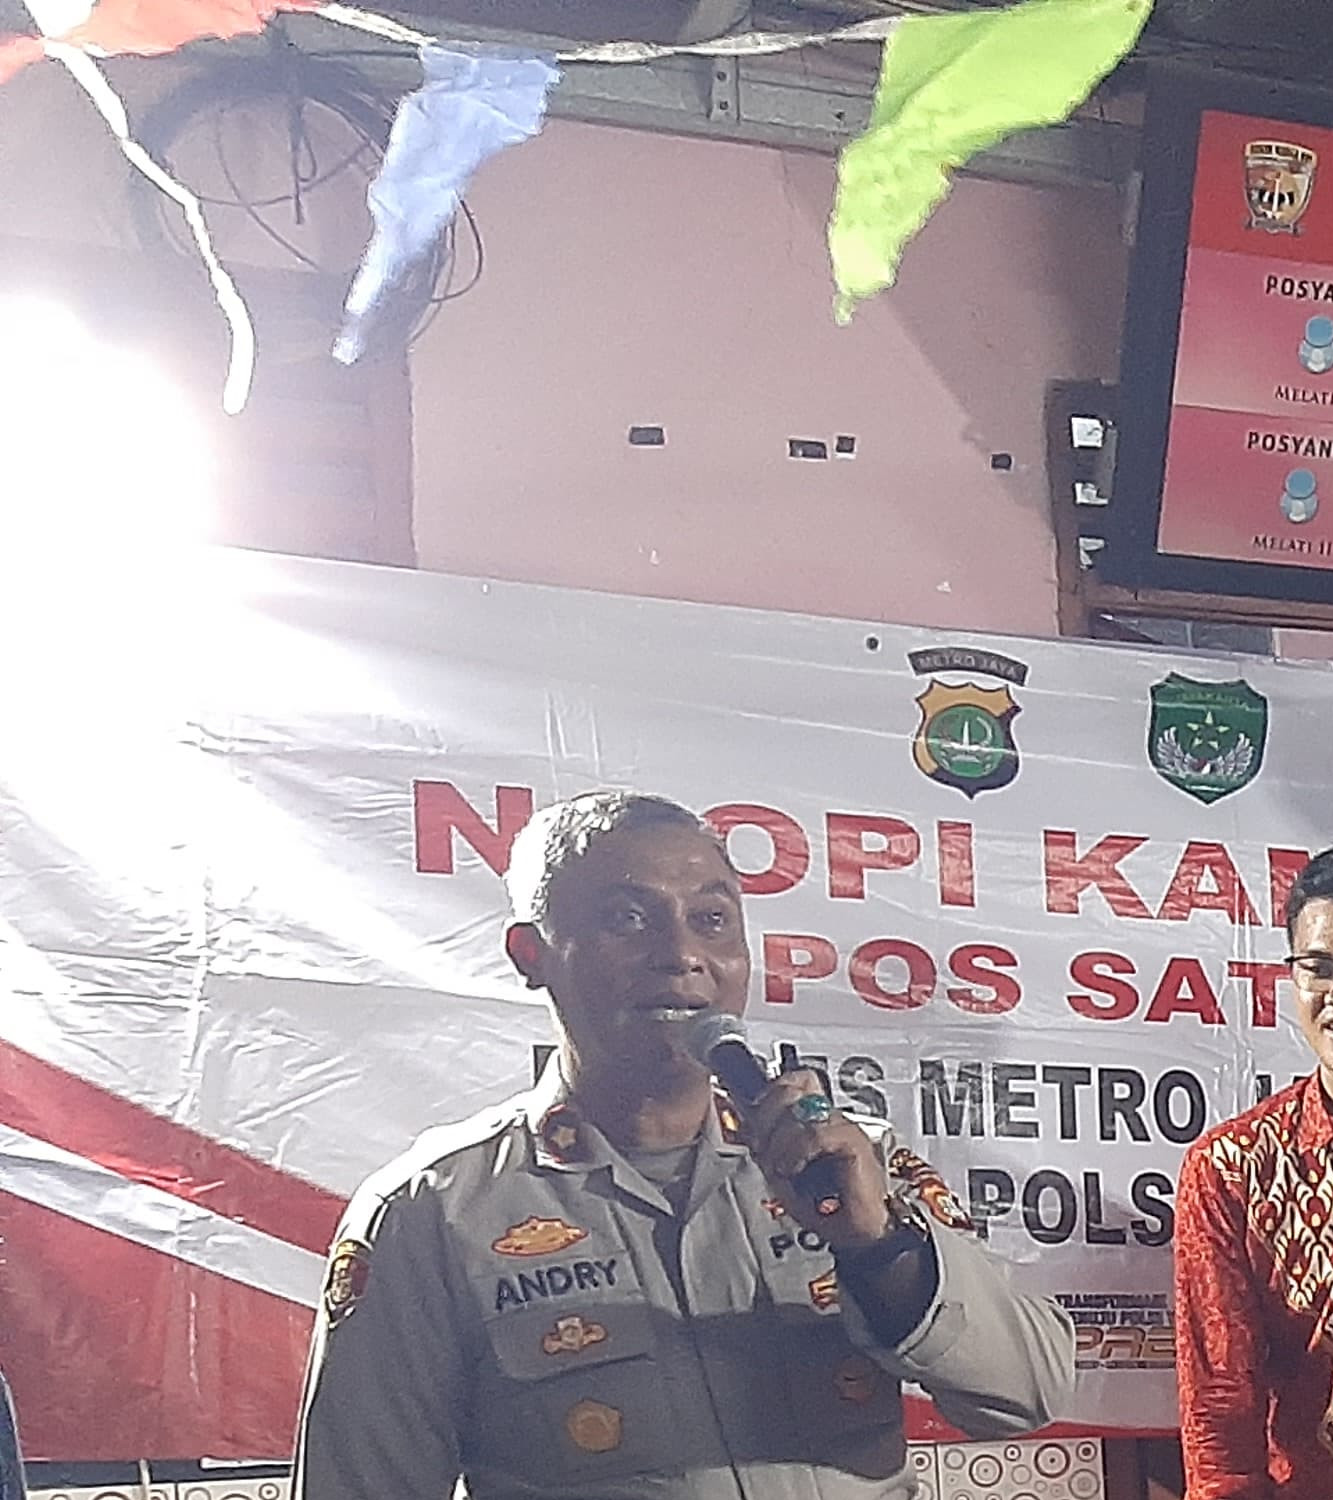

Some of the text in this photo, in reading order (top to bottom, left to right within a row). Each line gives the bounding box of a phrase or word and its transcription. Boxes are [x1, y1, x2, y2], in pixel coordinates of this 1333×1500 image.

[1253, 534, 1315, 555] MELATI
[412, 778, 976, 909] NOPI
[762, 933, 1023, 1016] POS
[919, 1057, 1208, 1145] METRO
[967, 1168, 1175, 1247] POLS
[494, 1258, 619, 1311] ANDRY
